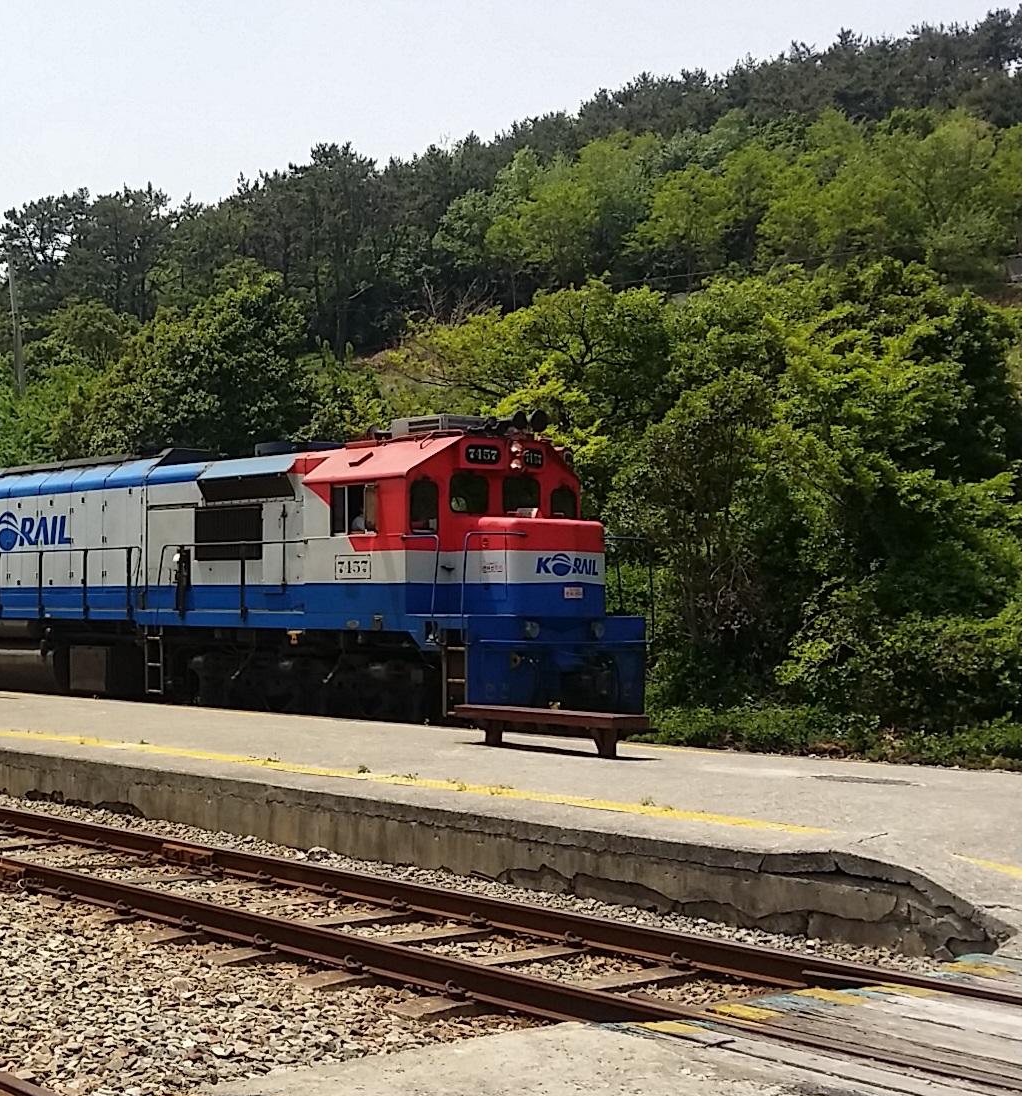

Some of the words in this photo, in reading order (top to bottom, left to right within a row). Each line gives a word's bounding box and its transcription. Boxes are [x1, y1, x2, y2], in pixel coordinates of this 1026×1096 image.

[468, 448, 497, 460] 7457
[338, 560, 368, 574] 7457
[535, 553, 599, 577] KORAIL
